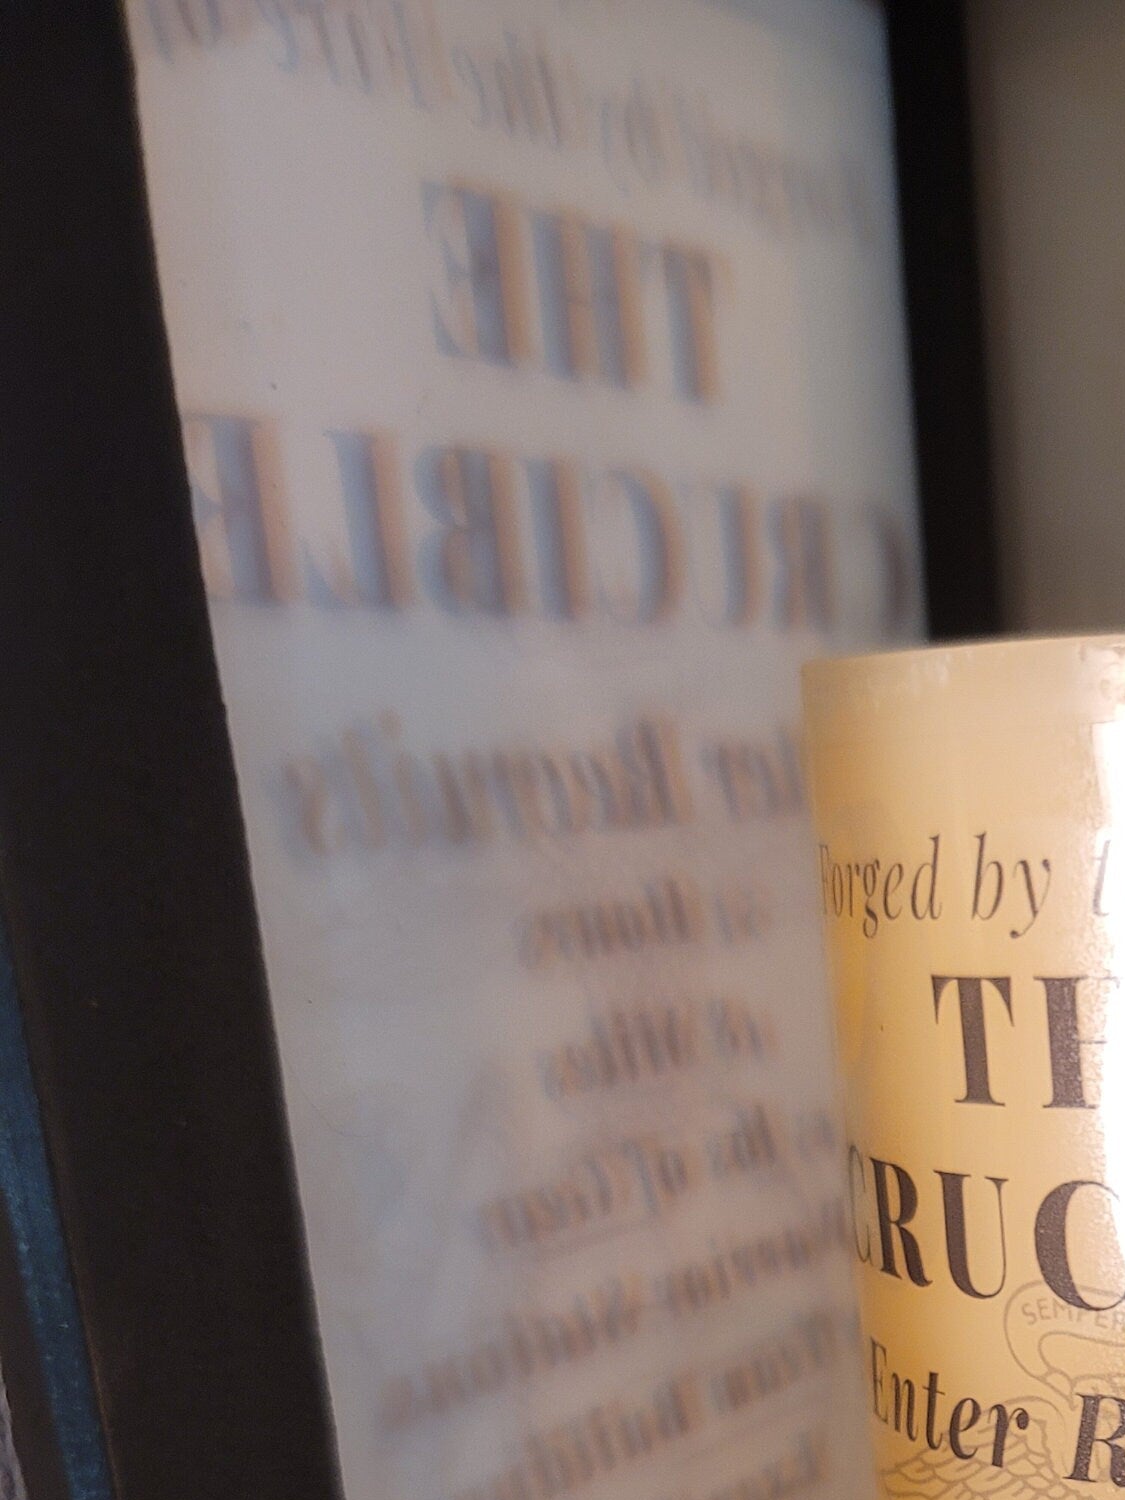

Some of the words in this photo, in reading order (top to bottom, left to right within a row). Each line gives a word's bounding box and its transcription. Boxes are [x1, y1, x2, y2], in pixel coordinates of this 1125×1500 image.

[818, 830, 943, 939] Forged
[970, 830, 1052, 939] by
[868, 1336, 1031, 1470] Enter
